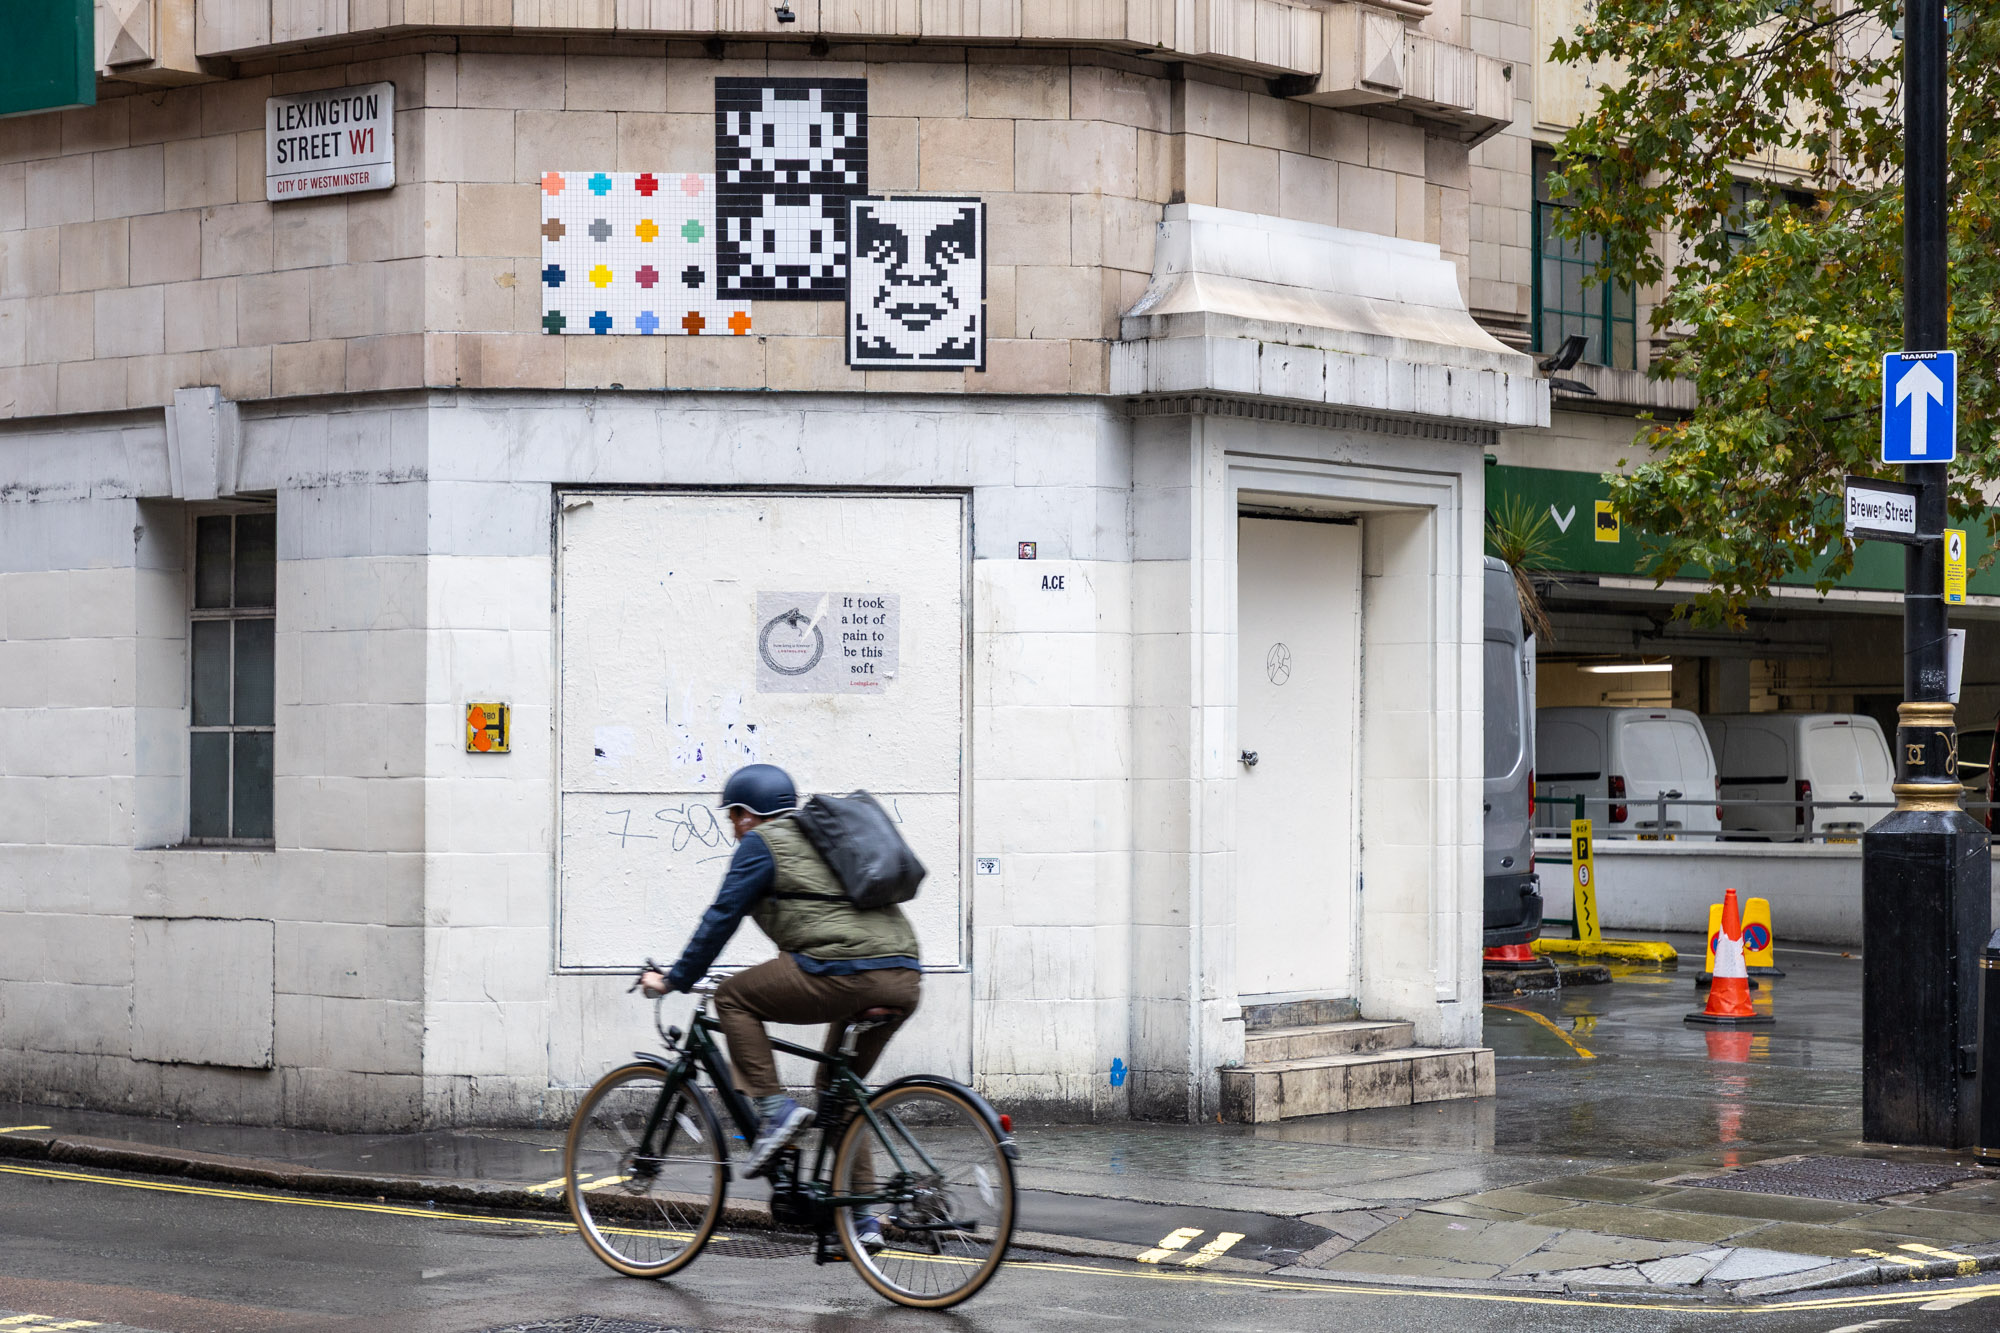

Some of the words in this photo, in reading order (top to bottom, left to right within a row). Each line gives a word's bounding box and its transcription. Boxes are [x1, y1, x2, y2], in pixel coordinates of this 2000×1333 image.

[277, 94, 378, 132] LEXINGTON
[277, 132, 342, 164] STREET
[349, 127, 374, 155] W1
[277, 179, 295, 193] CITY
[297, 179, 308, 191] OF
[310, 172, 369, 189] WESTMINSTER
[1850, 496, 1882, 519] Brewer
[1885, 501, 1913, 523] Street
[1041, 575, 1065, 590] A.CE
[842, 597, 853, 608] It
[857, 597, 885, 609] took
[841, 616, 848, 624] a
[852, 613, 868, 625] lot
[873, 613, 886, 625] of
[842, 629, 868, 643] pain
[872, 631, 885, 641] to
[843, 646, 857, 657] be
[861, 646, 883, 657] this
[851, 662, 874, 674] soft
[1579, 840, 1586, 857] P
